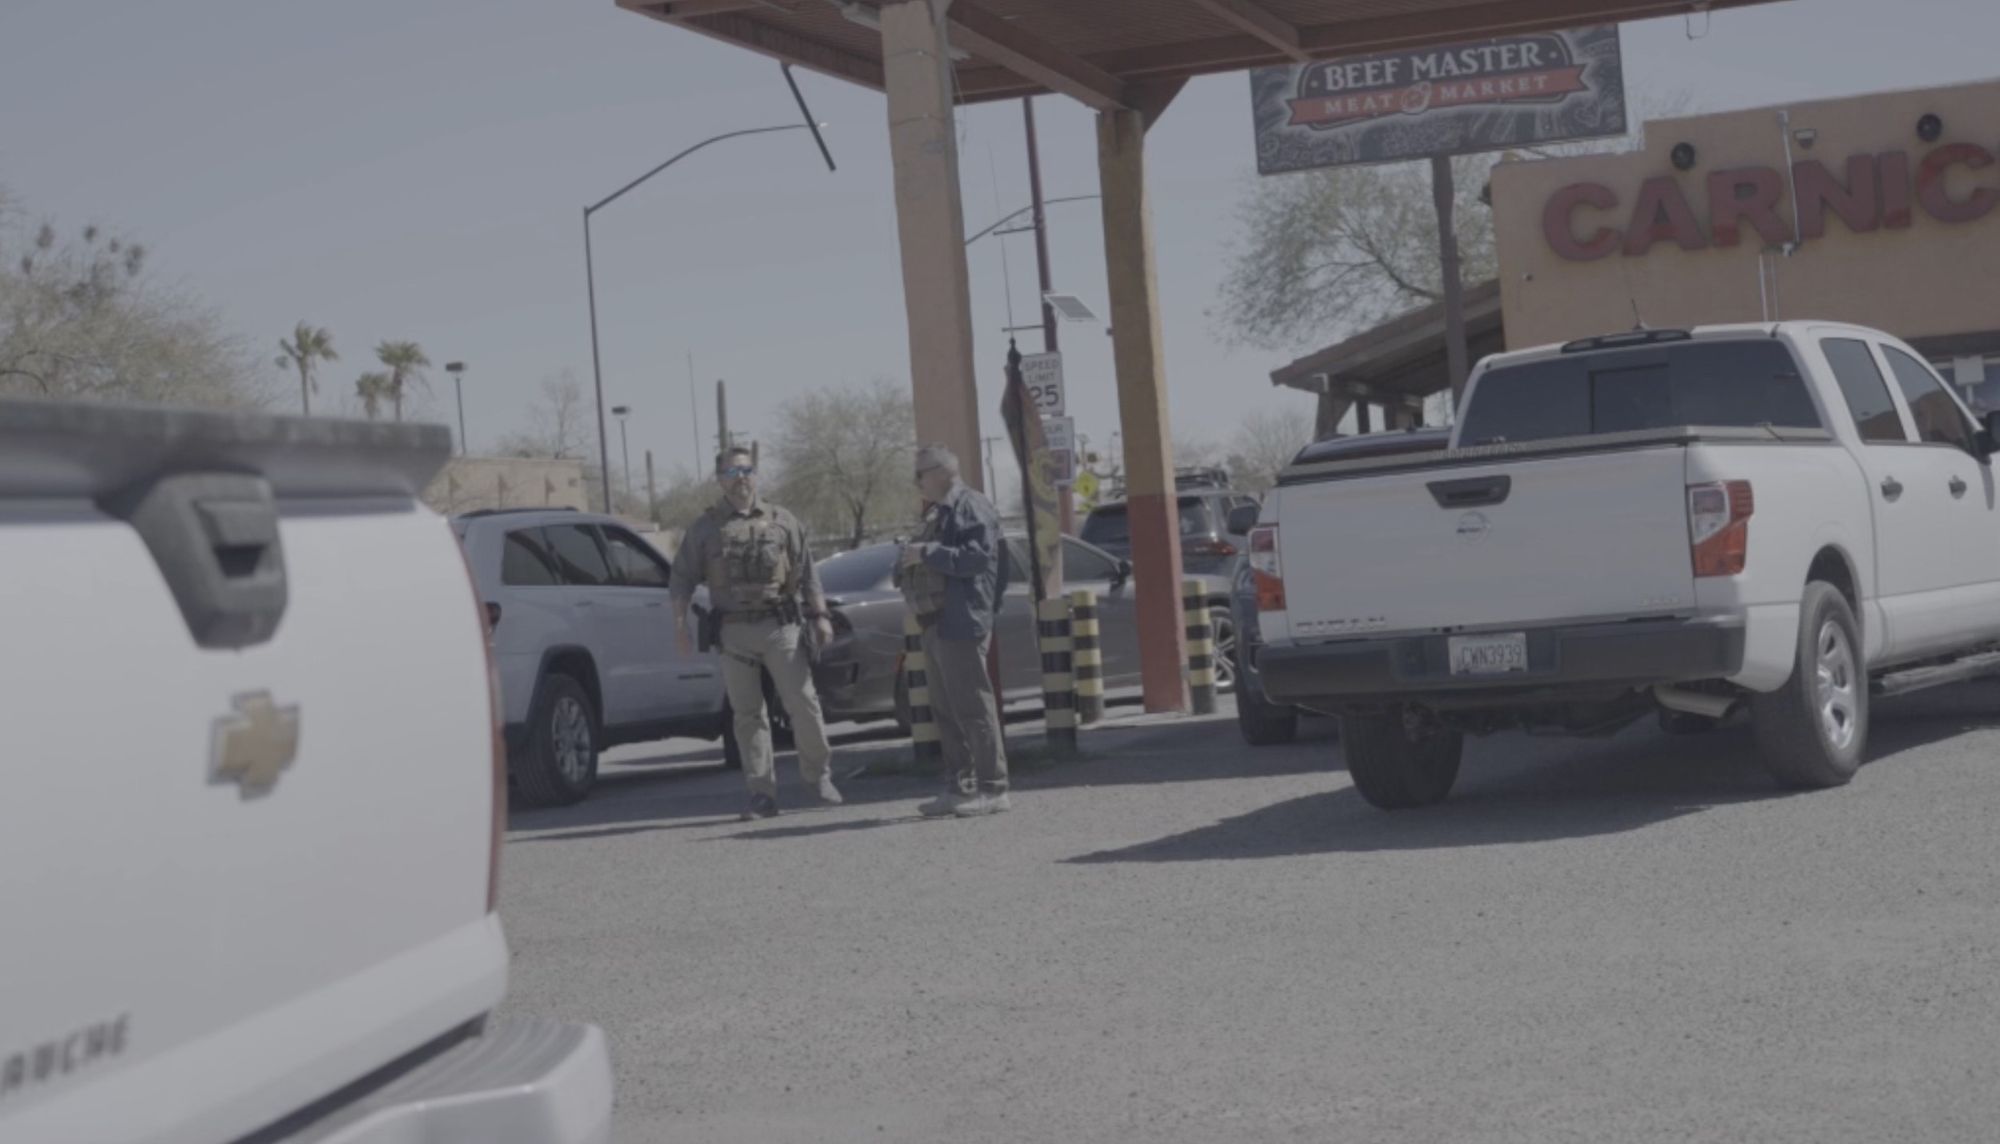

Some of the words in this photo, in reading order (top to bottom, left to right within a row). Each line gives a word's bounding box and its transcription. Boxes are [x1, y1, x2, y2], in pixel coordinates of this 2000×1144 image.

[1323, 58, 1402, 91] BEEF
[1411, 41, 1544, 81] MASTER
[1323, 93, 1394, 115] MEAT
[1439, 75, 1549, 102] MARKET
[1024, 359, 1060, 371] SPEED
[1028, 372, 1057, 384] LIMIT
[1029, 384, 1060, 407] 25
